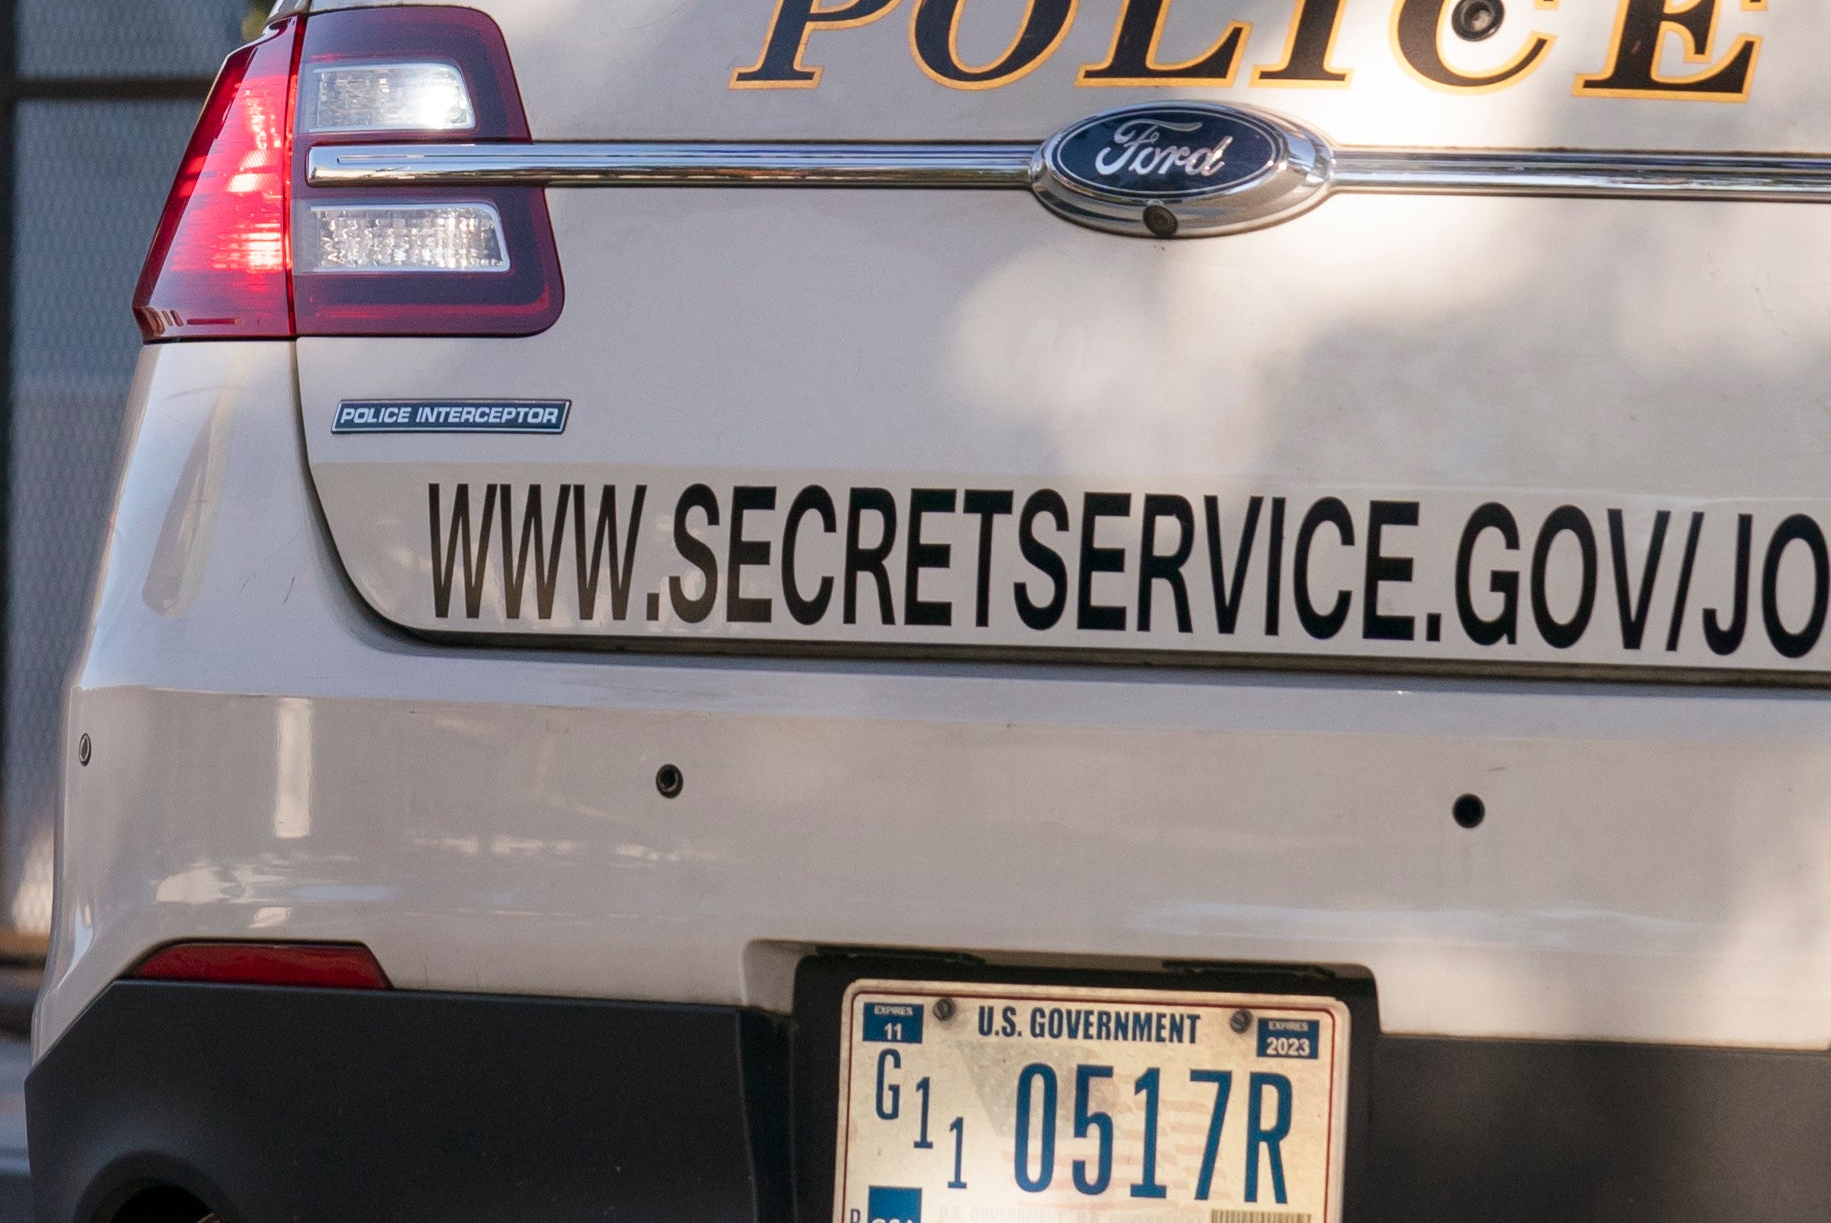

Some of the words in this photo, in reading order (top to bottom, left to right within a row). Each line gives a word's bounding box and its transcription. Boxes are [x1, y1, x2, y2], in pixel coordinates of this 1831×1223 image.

[1095, 118, 1233, 176] Ford
[340, 407, 411, 424] POLICE
[416, 407, 559, 424] INTERCEPTOR
[427, 482, 1831, 658] WWW.SECRETSERVICE.GOV/JO
[873, 1005, 914, 1016] EXPIRES
[884, 1022, 903, 1040] 11
[978, 1005, 1022, 1038] U.S.
[1029, 1007, 1201, 1044] GOVERNMENT
[1268, 1020, 1310, 1032] EXPIRES
[1265, 1036, 1311, 1056] 2023
[1014, 1062, 1293, 1205] 0517R
